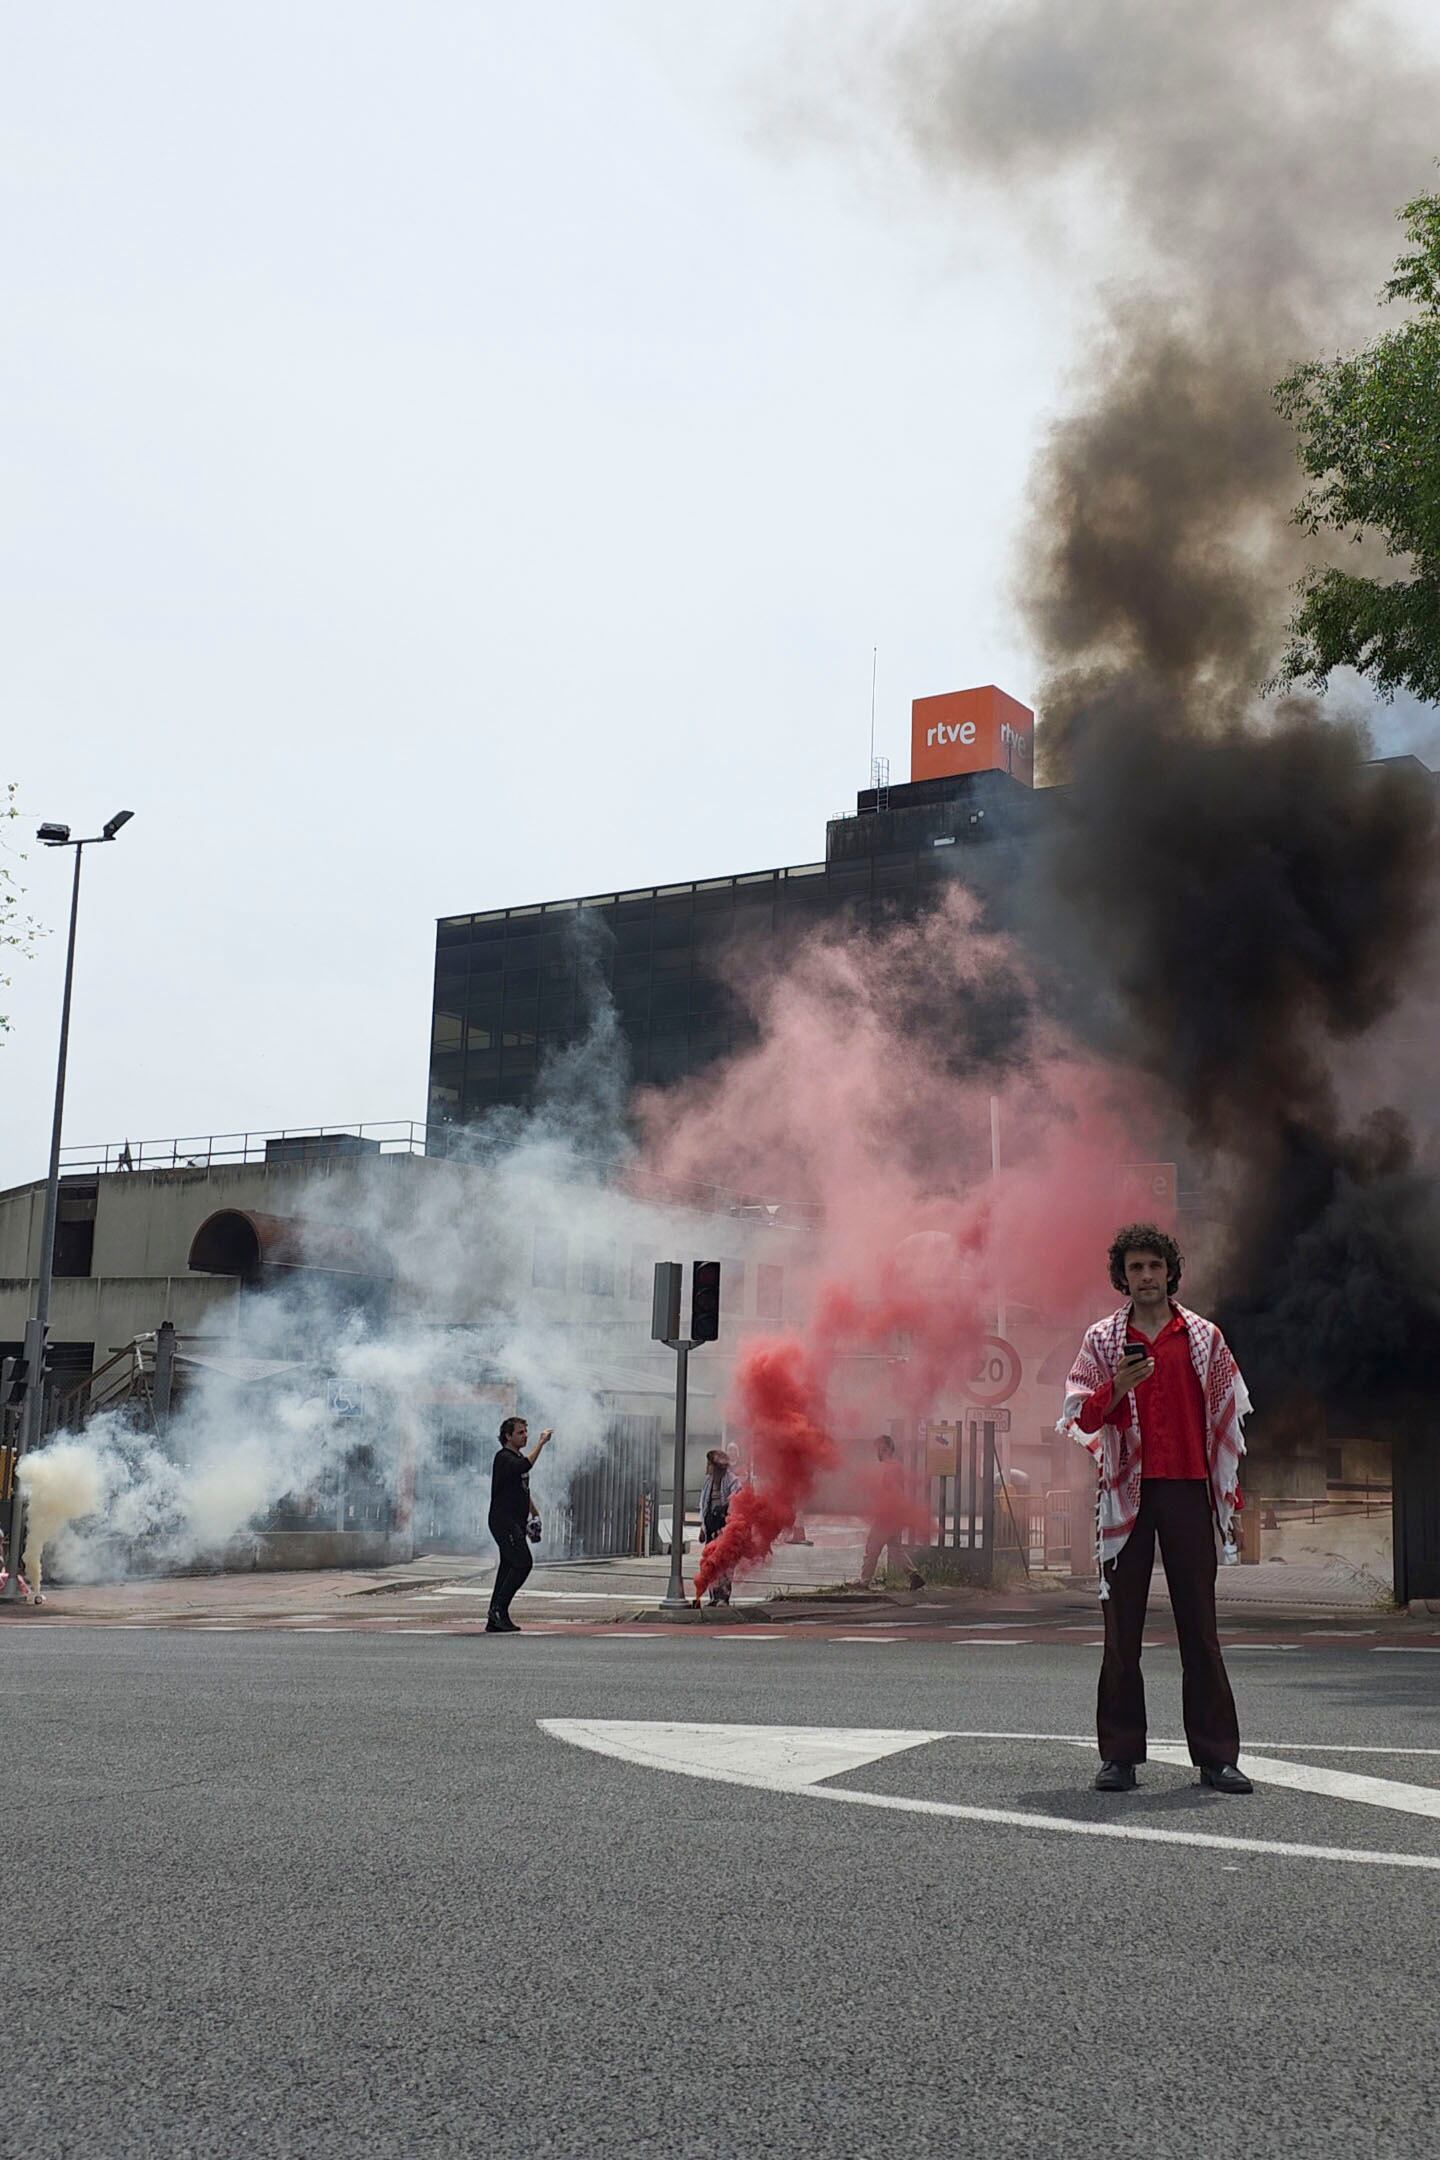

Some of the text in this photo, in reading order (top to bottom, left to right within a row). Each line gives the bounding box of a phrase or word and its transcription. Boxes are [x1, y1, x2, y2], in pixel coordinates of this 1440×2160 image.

[927, 721, 976, 746] rtve
[1001, 722, 1026, 757] rtve
[969, 1358, 1004, 1383] 20
